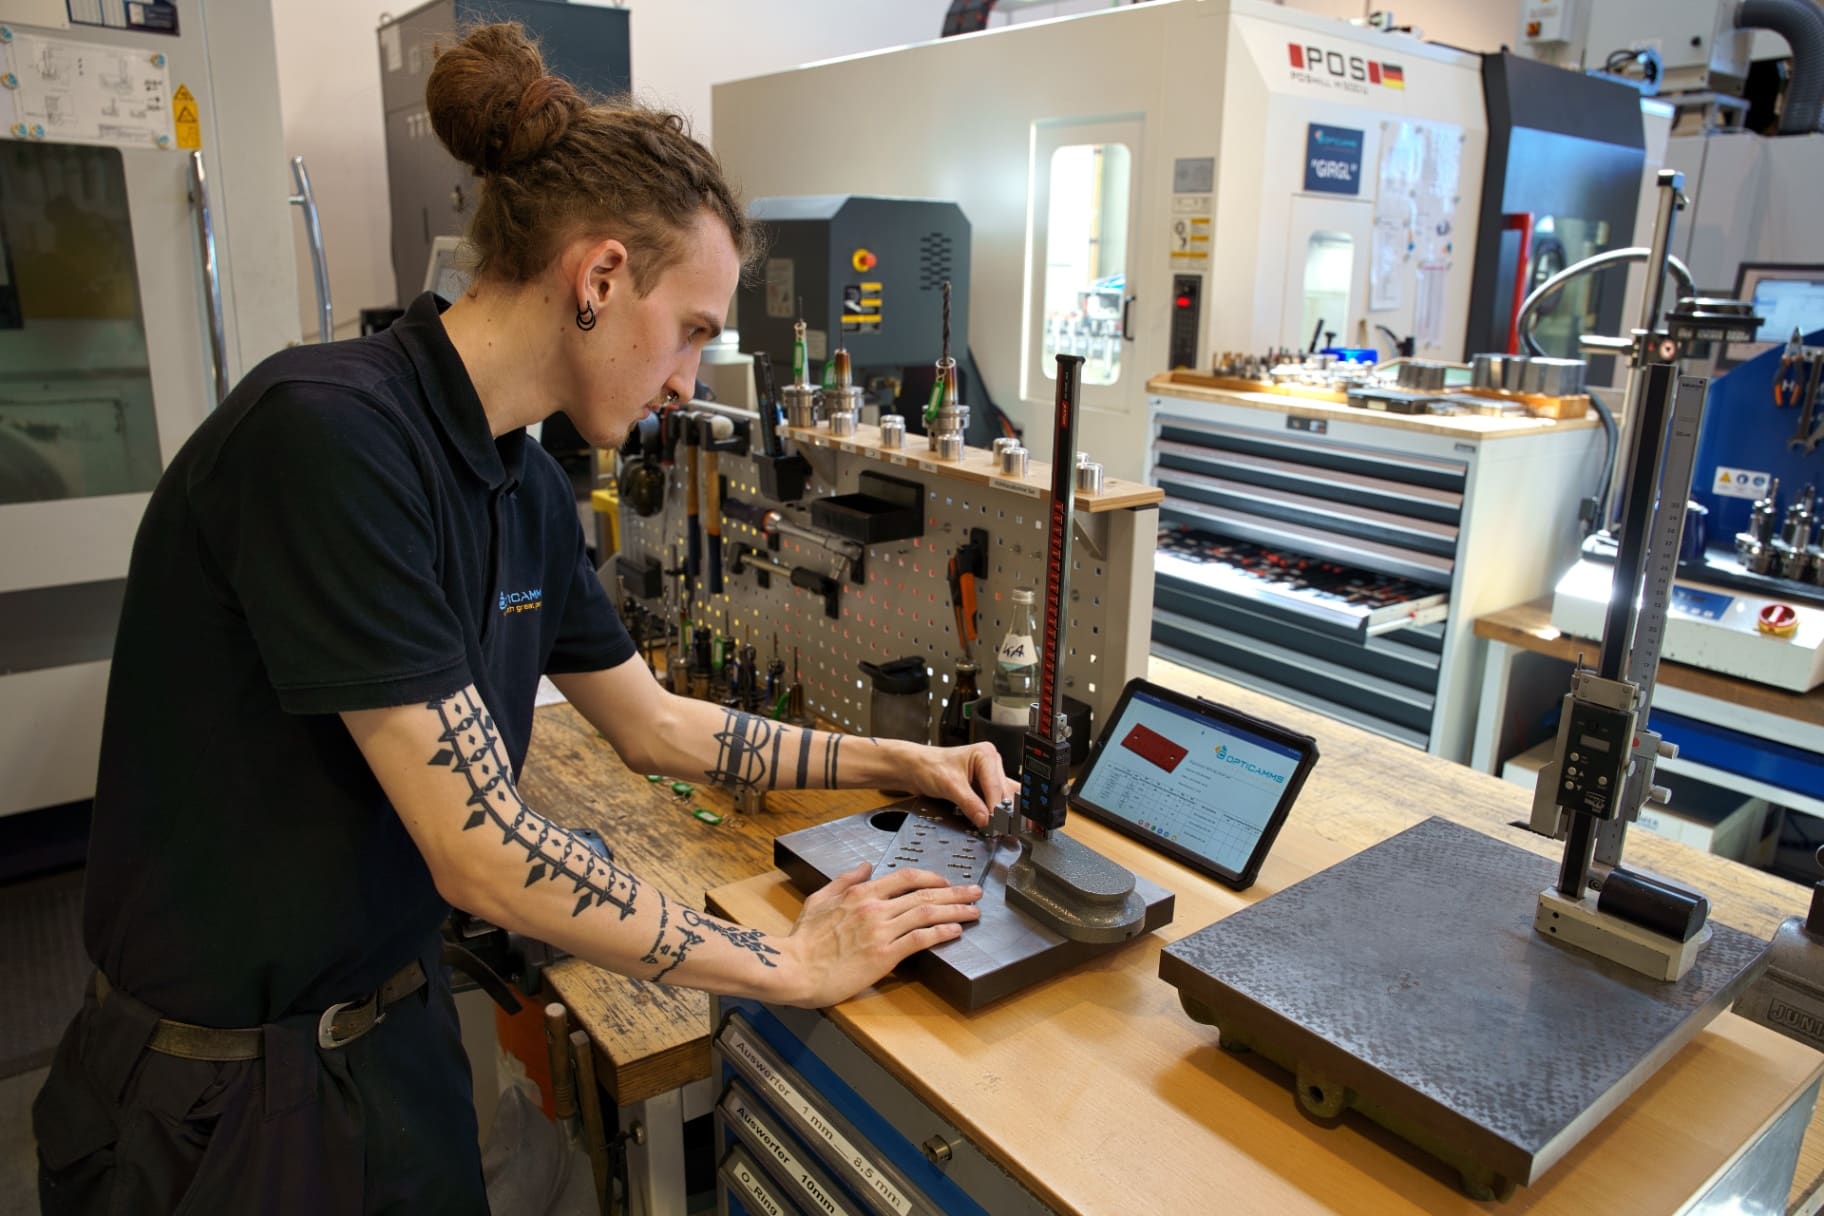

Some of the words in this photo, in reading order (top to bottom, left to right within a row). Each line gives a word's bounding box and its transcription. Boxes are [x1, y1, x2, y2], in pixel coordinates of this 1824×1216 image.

[1306, 46, 1365, 81] POS
[1226, 755, 1284, 783] OPTICAMMS
[811, 1115, 833, 1140] mm
[875, 1179, 900, 1208] mm
[801, 1174, 835, 1214] 10mm
